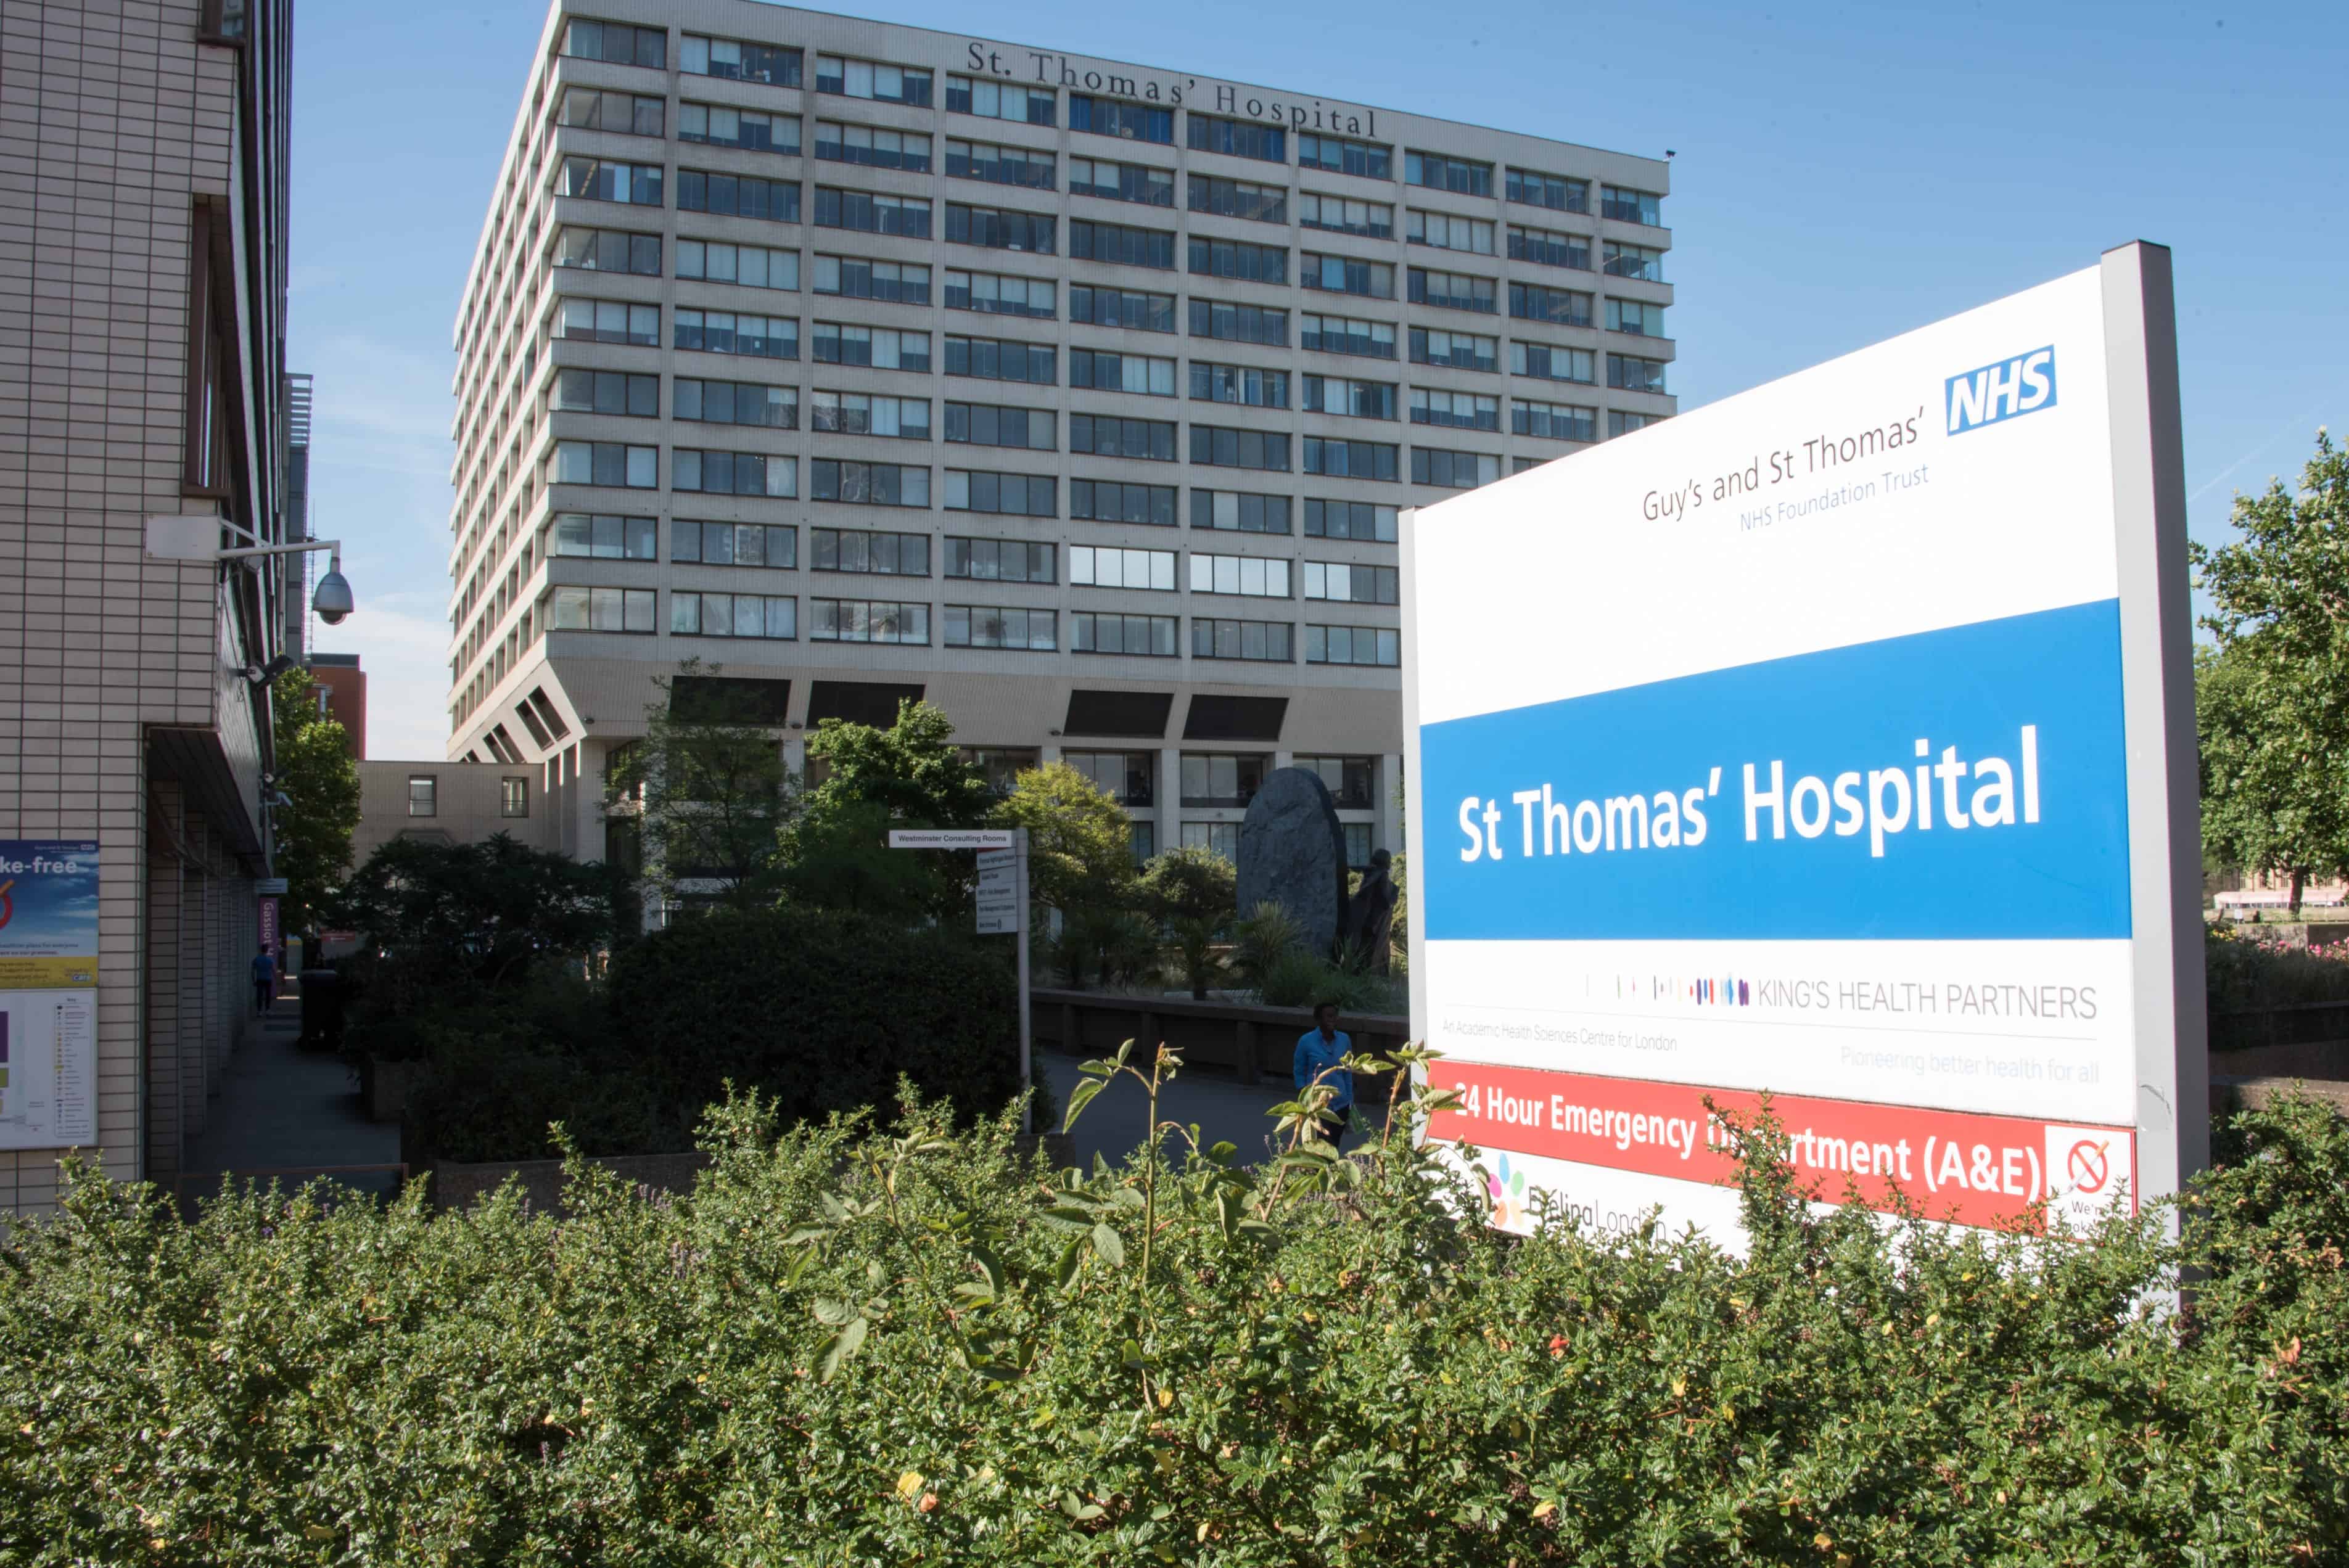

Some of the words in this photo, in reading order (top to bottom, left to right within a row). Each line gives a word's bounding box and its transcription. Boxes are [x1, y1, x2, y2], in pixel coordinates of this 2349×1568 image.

[967, 43, 1011, 76] St.
[1031, 52, 1196, 104] Thomas'
[1215, 85, 1377, 138] Hospital
[1948, 349, 2052, 433] NHS
[1642, 478, 1703, 522] Guy's
[1712, 456, 1759, 501] and
[1769, 449, 1795, 485] St
[1803, 405, 1925, 474] Thomas'
[1740, 504, 1773, 533] NHS
[1777, 478, 1877, 523] Foundation
[1881, 462, 1930, 495] Trust
[1458, 795, 1503, 863] St
[1512, 766, 1722, 858] Thomas'
[1742, 724, 2040, 858] Hospital
[898, 834, 942, 842] Westminster
[944, 834, 981, 844] Consulting
[982, 834, 1007, 842] Rooms
[1456, 1019, 1500, 1038] Academic
[1501, 1022, 1532, 1041] Health
[1534, 1024, 1578, 1044] Sciences
[1579, 1027, 1615, 1046] Centre
[1617, 1030, 1633, 1048] for
[1634, 1033, 1677, 1051] London
[1758, 978, 1830, 1009] KING'S
[1839, 981, 1936, 1014] HEALTH
[1947, 983, 2097, 1020] PARTNERS
[1840, 1045, 1925, 1076] Pioneering
[1929, 1052, 1981, 1077] better
[1984, 1055, 2043, 1080] health
[2047, 1057, 2073, 1082] for
[2077, 1060, 2100, 1085] all
[1487, 1085, 1545, 1127] Hour
[1550, 1094, 1697, 1160] Emergency
[1922, 1136, 2041, 1206] (A&E)
